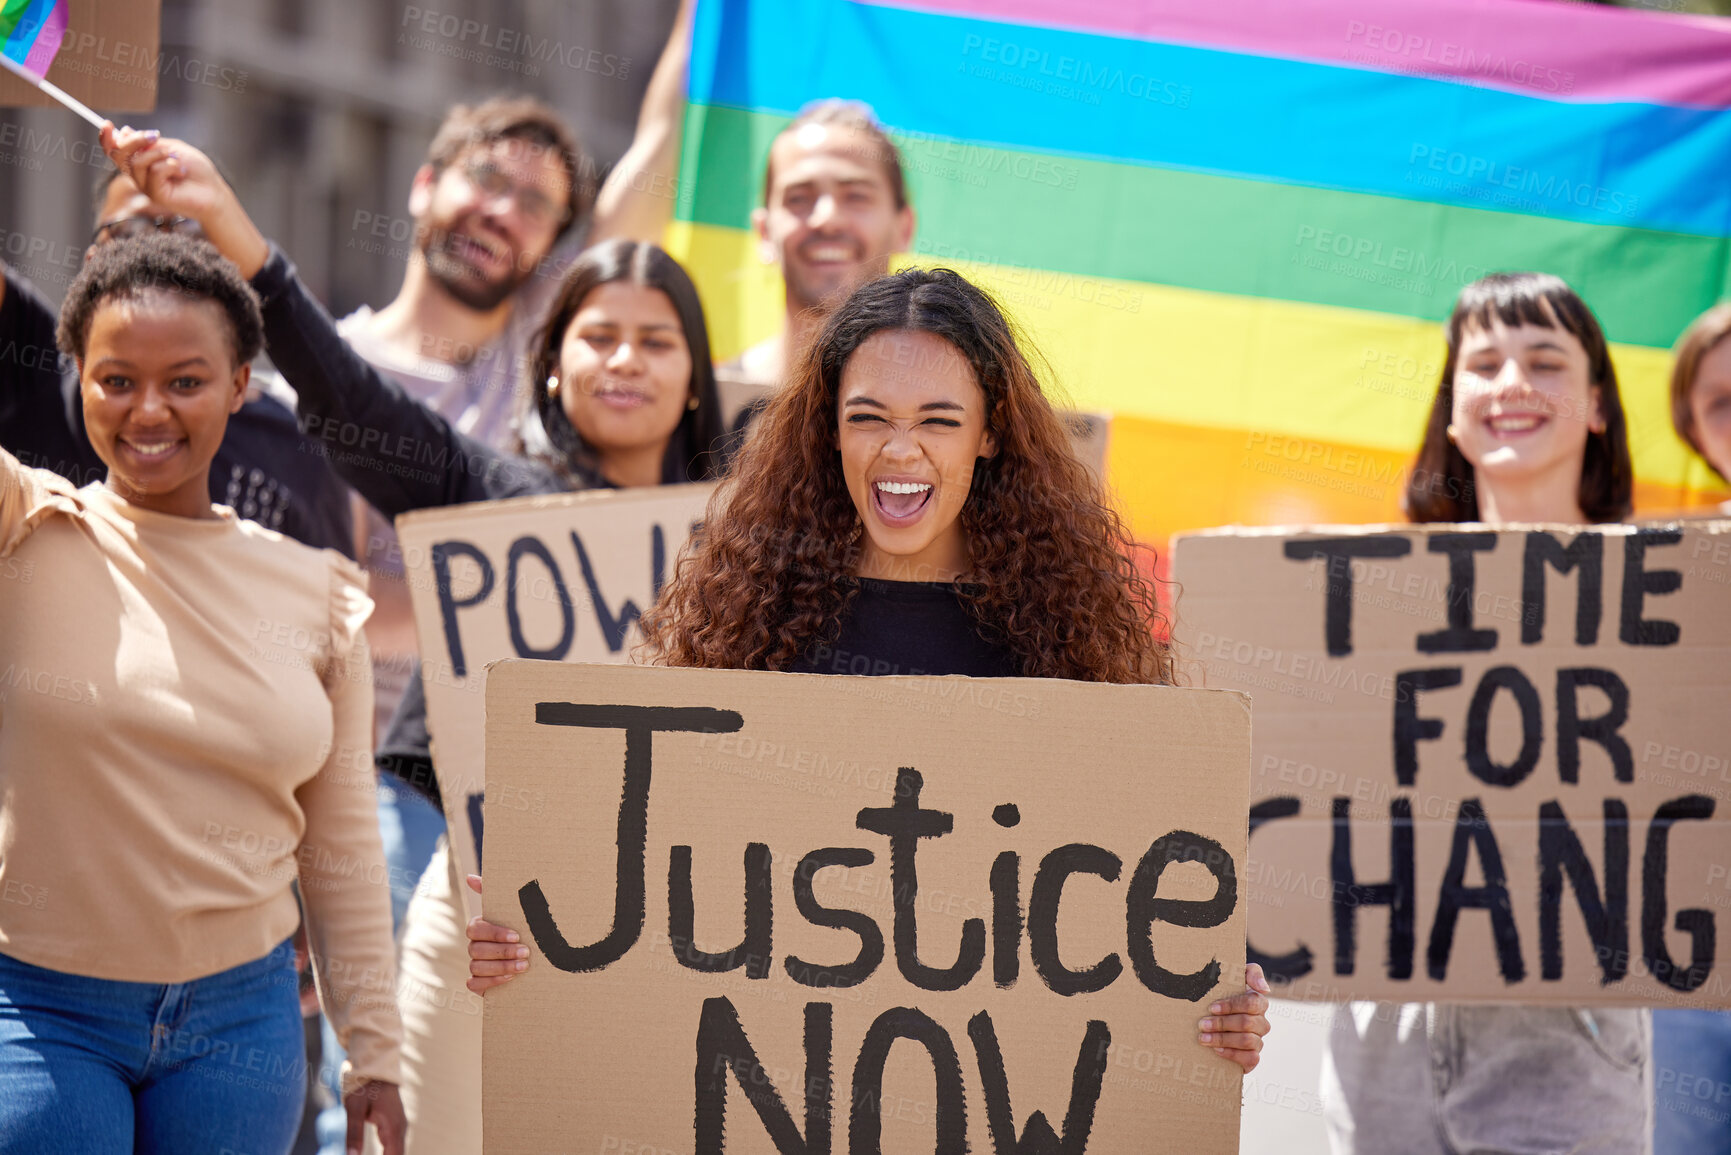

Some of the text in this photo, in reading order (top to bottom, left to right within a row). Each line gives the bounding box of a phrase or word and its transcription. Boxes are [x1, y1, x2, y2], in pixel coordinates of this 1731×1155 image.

[431, 520, 705, 678] POW
[1284, 531, 1682, 658] TIME
[1392, 665, 1634, 789] FOR
[518, 701, 1239, 1002] Justice
[1246, 794, 1716, 993] CHANG
[694, 995, 1112, 1155] NOW
